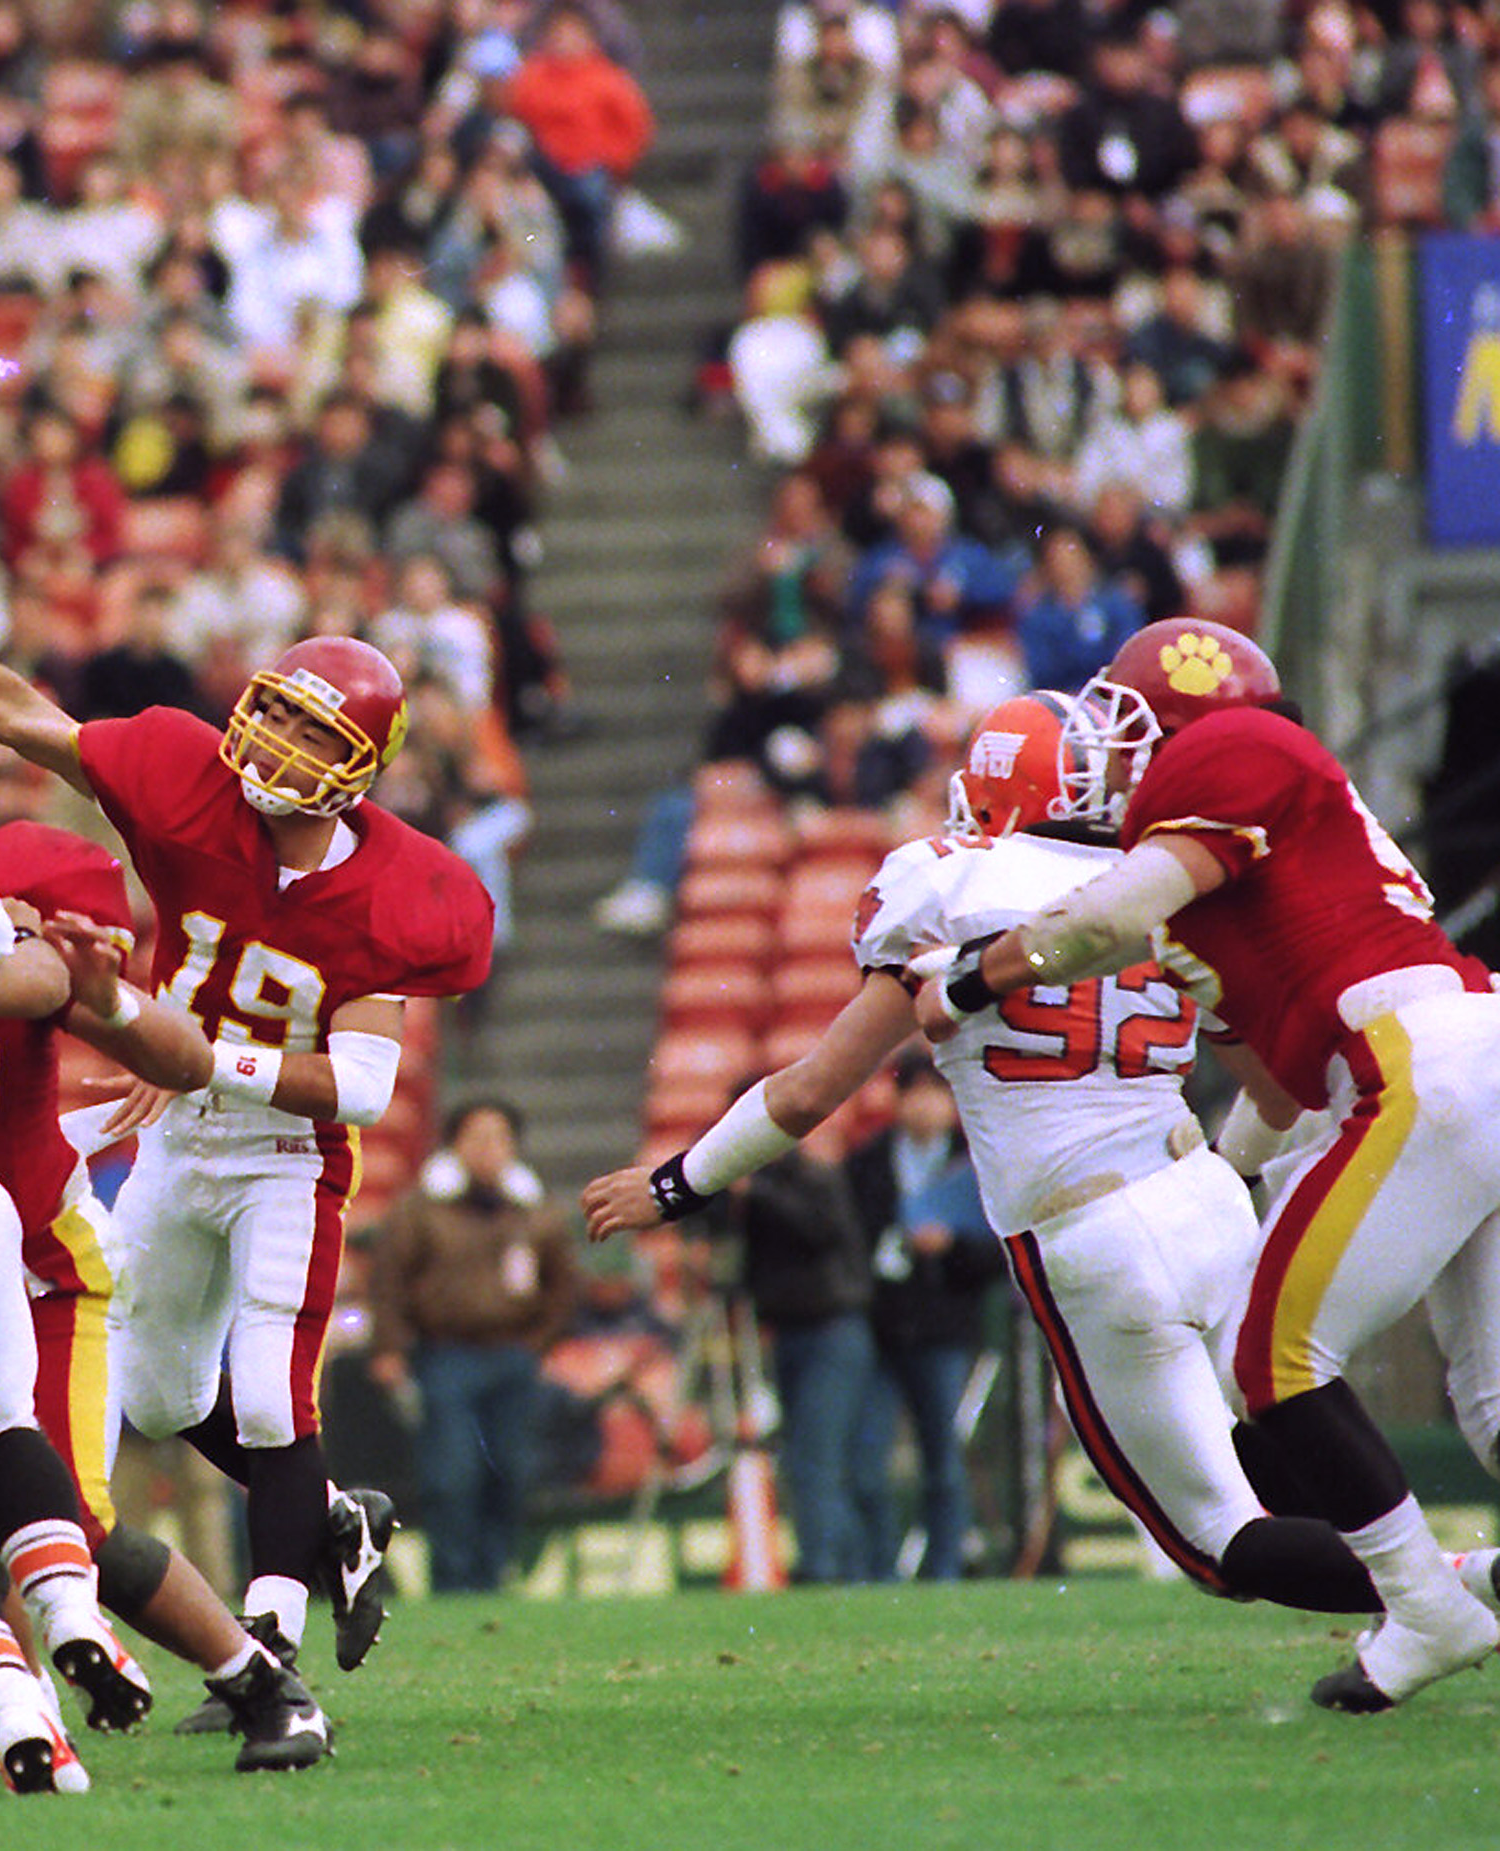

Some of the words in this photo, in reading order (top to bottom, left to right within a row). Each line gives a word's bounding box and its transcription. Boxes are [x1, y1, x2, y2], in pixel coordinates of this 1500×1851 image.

[155, 910, 327, 1053] 19
[982, 958, 1198, 1082] 92
[236, 1055, 258, 1078] 19
